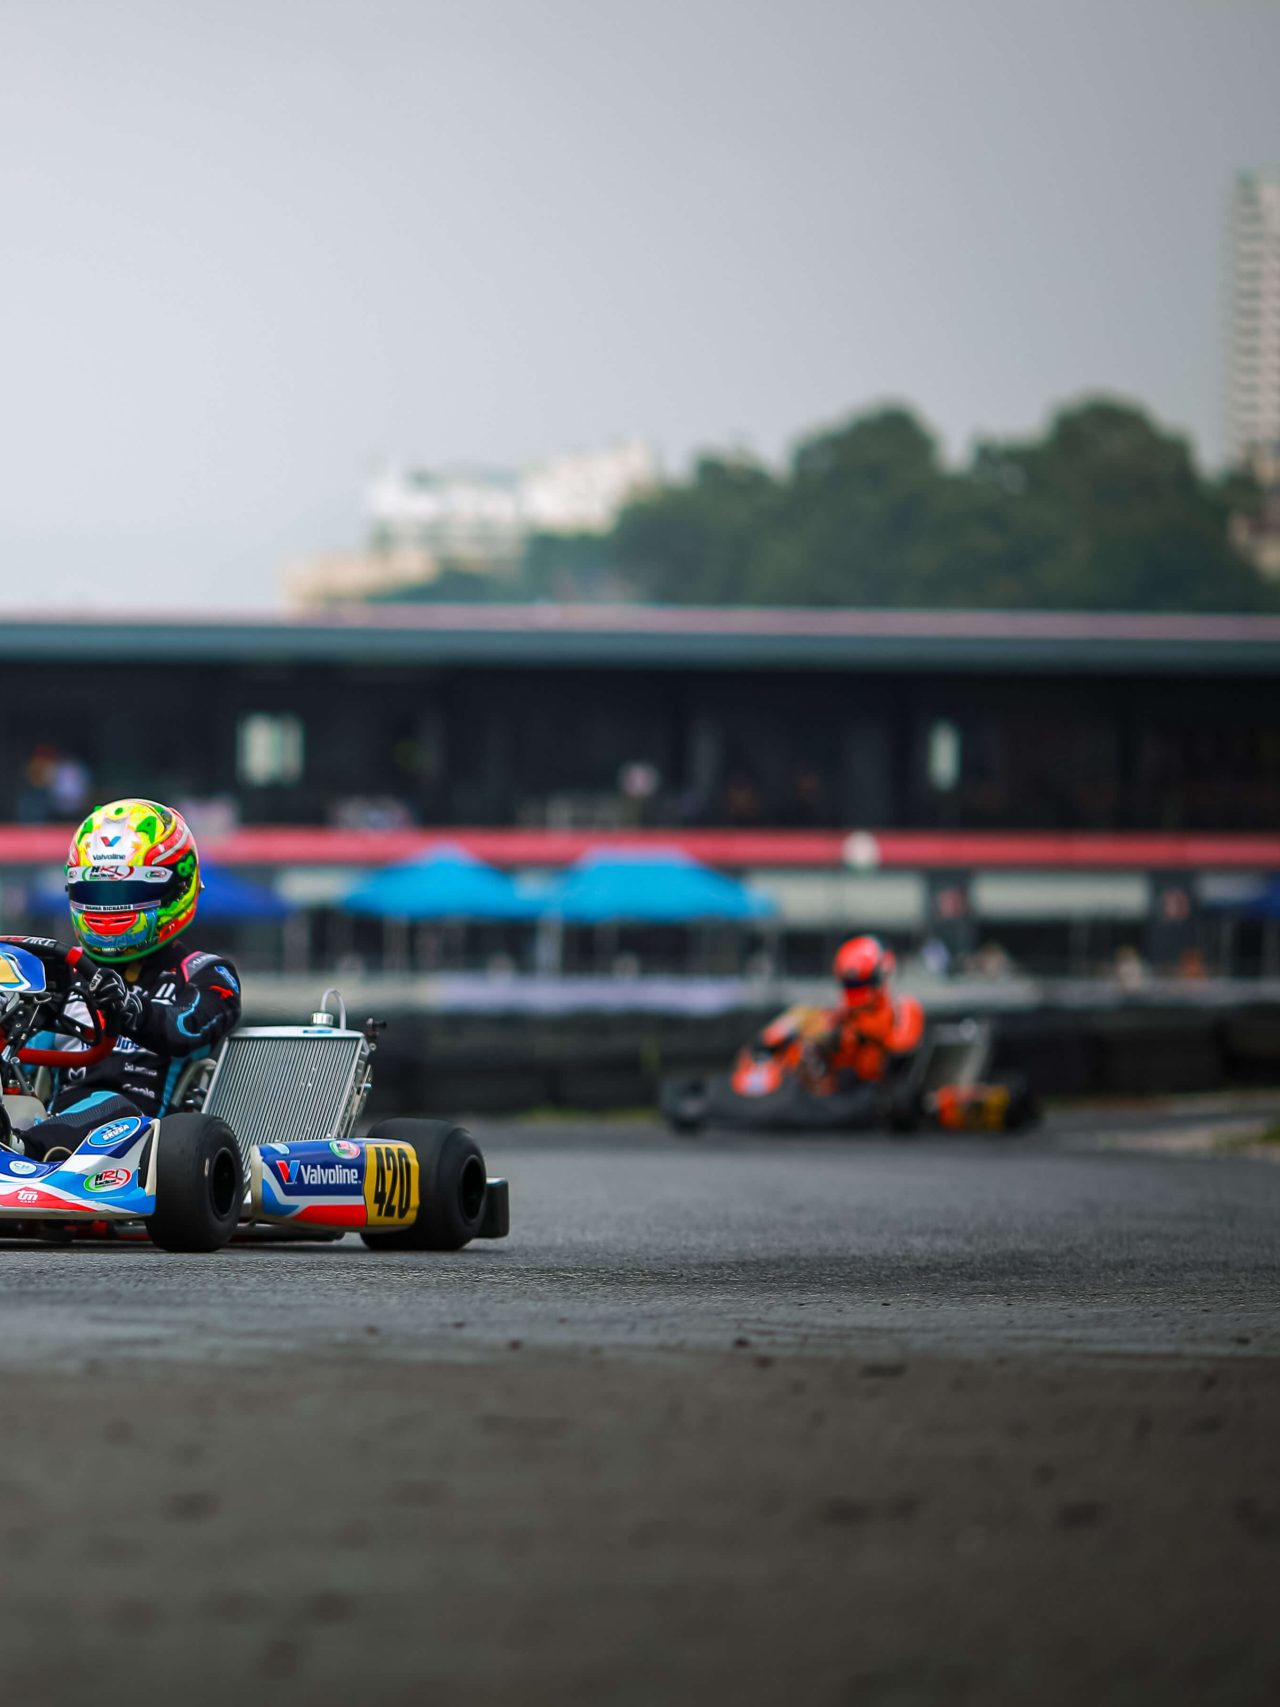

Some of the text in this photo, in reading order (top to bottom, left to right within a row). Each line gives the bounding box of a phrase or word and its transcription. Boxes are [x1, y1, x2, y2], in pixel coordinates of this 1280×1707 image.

[92, 853, 126, 861] Valvoline
[102, 1124, 130, 1141] SKUSA
[300, 1164, 360, 1185] Valvoline
[373, 1145, 411, 1220] 420
[17, 1190, 39, 1201] tm
